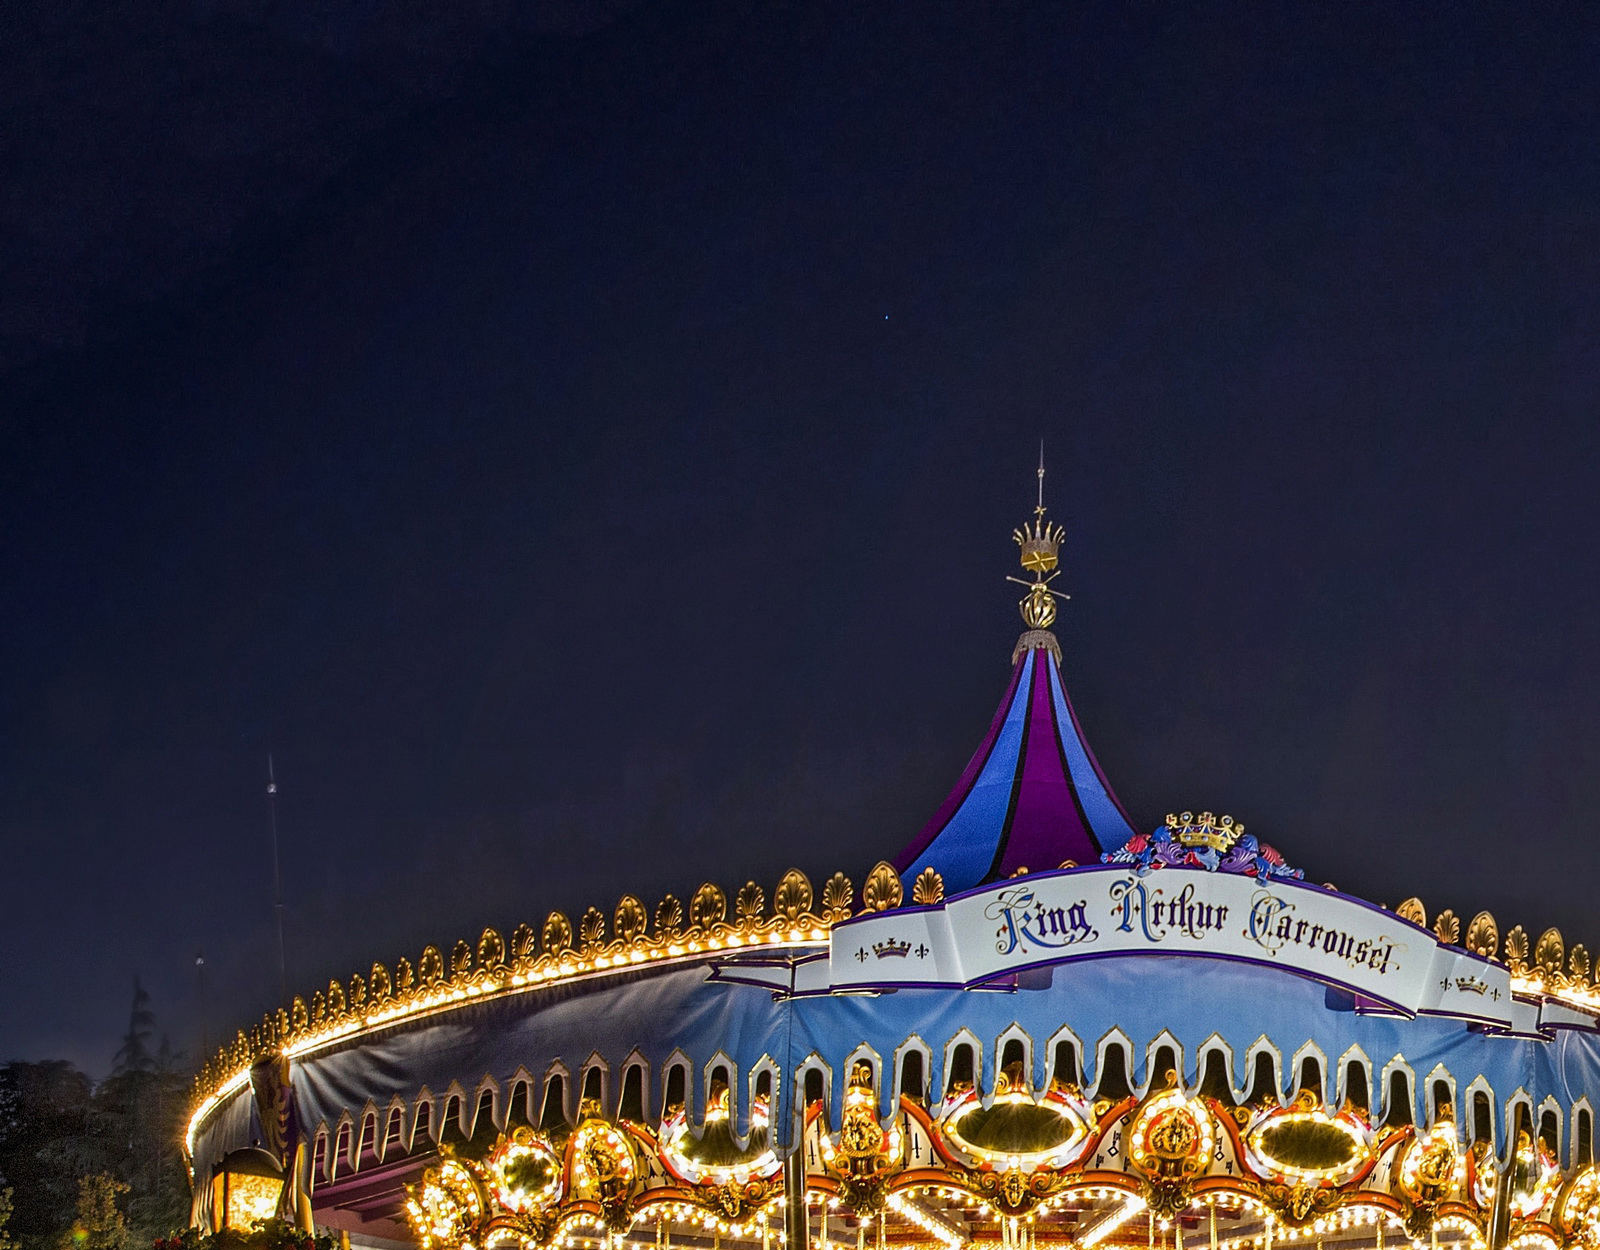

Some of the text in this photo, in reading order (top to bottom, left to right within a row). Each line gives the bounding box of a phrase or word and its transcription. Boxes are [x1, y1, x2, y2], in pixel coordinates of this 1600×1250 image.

[984, 877, 1409, 974] King Arthur Carrousel
